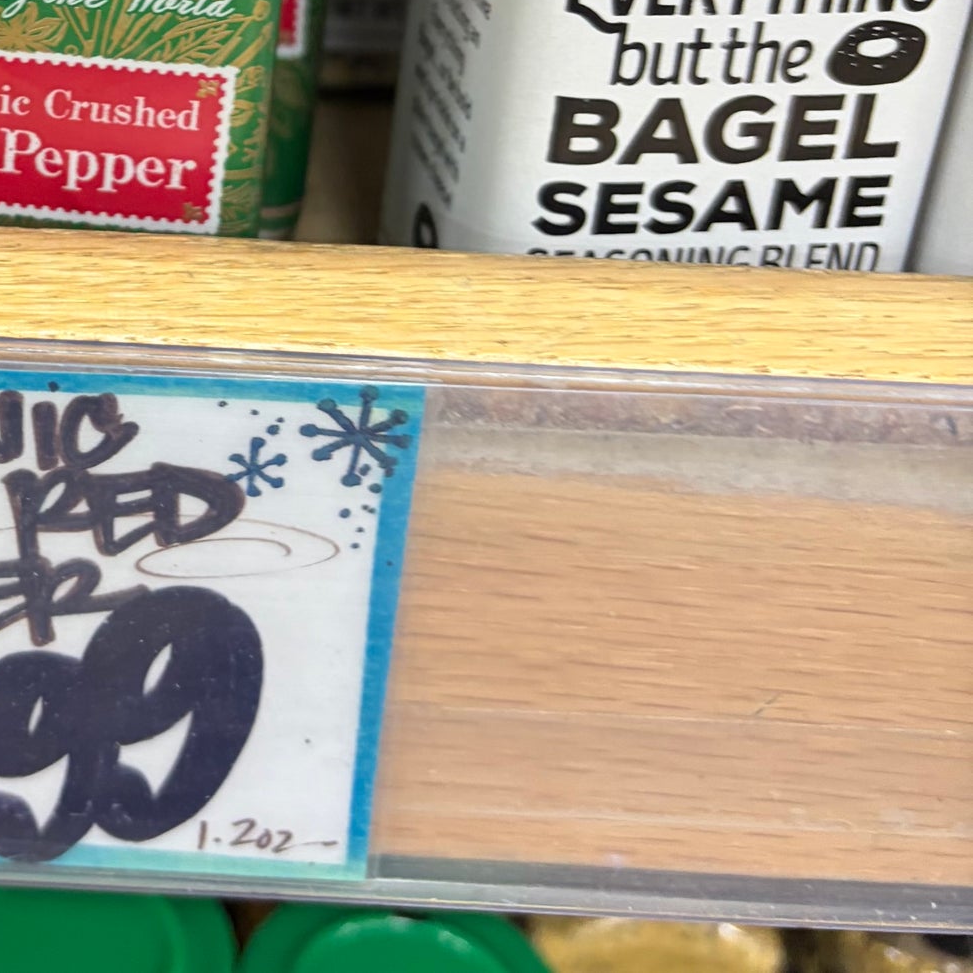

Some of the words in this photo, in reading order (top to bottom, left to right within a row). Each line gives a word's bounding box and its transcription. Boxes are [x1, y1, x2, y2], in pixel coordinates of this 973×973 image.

[610, 23, 712, 87] but
[721, 21, 814, 86] the
[44, 88, 200, 131] Crushed
[545, 93, 900, 166] BAGEL
[530, 175, 893, 237] SESAME
[1, 461, 248, 557] RED
